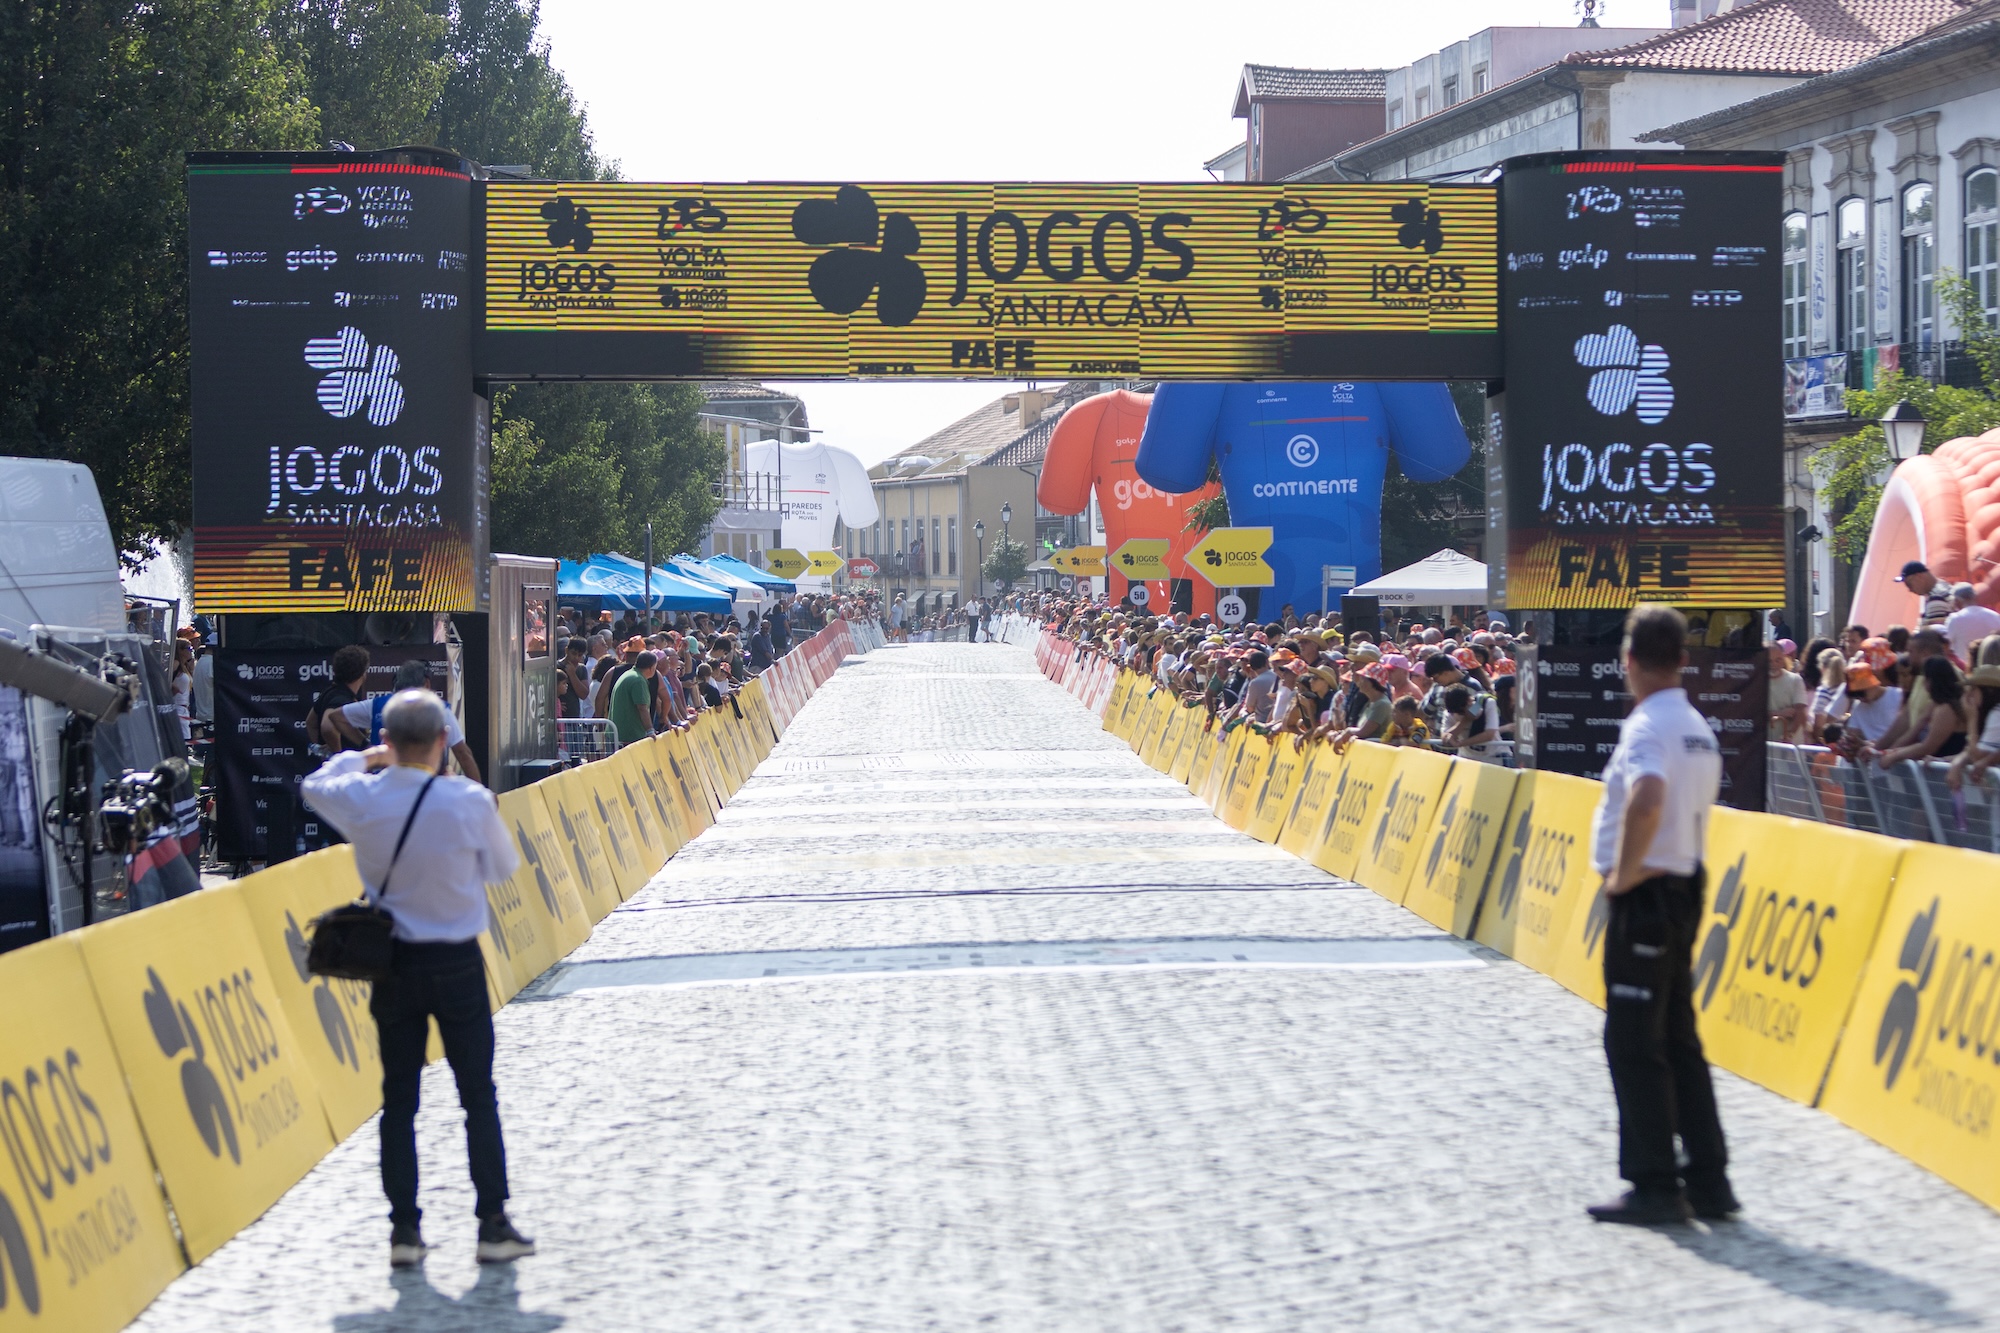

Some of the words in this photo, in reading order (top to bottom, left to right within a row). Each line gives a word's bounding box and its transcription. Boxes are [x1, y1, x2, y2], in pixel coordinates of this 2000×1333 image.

[286, 244, 338, 270] galp
[658, 248, 728, 267] VOLTA
[948, 210, 1194, 306] JOGOS
[1258, 248, 1328, 268] VOLTA
[518, 262, 616, 300] JOGOS
[1370, 264, 1466, 300] JOGOS
[977, 293, 1194, 327] SANTACASA
[950, 340, 1035, 370] FAFE
[1116, 438, 1137, 447] galp
[266, 445, 443, 514] JOGOS
[1538, 443, 1716, 512] JOGOS
[791, 502, 823, 510] PAREDES
[1114, 479, 1183, 510] ga
[287, 503, 443, 528] SANTACASA
[1557, 501, 1716, 525] SANTACASA
[289, 547, 424, 591] FAFE
[1136, 555, 1159, 564] JOGOS
[1224, 551, 1258, 564] JOGOS
[1558, 545, 1691, 588] FAFE
[1134, 591, 1145, 600] 50
[1224, 603, 1240, 616] 25
[255, 666, 285, 677] JOGOS
[1596, 743, 1617, 753] RT
[1724, 886, 1837, 993] JOGOS
[194, 967, 279, 1125] JOGOS
